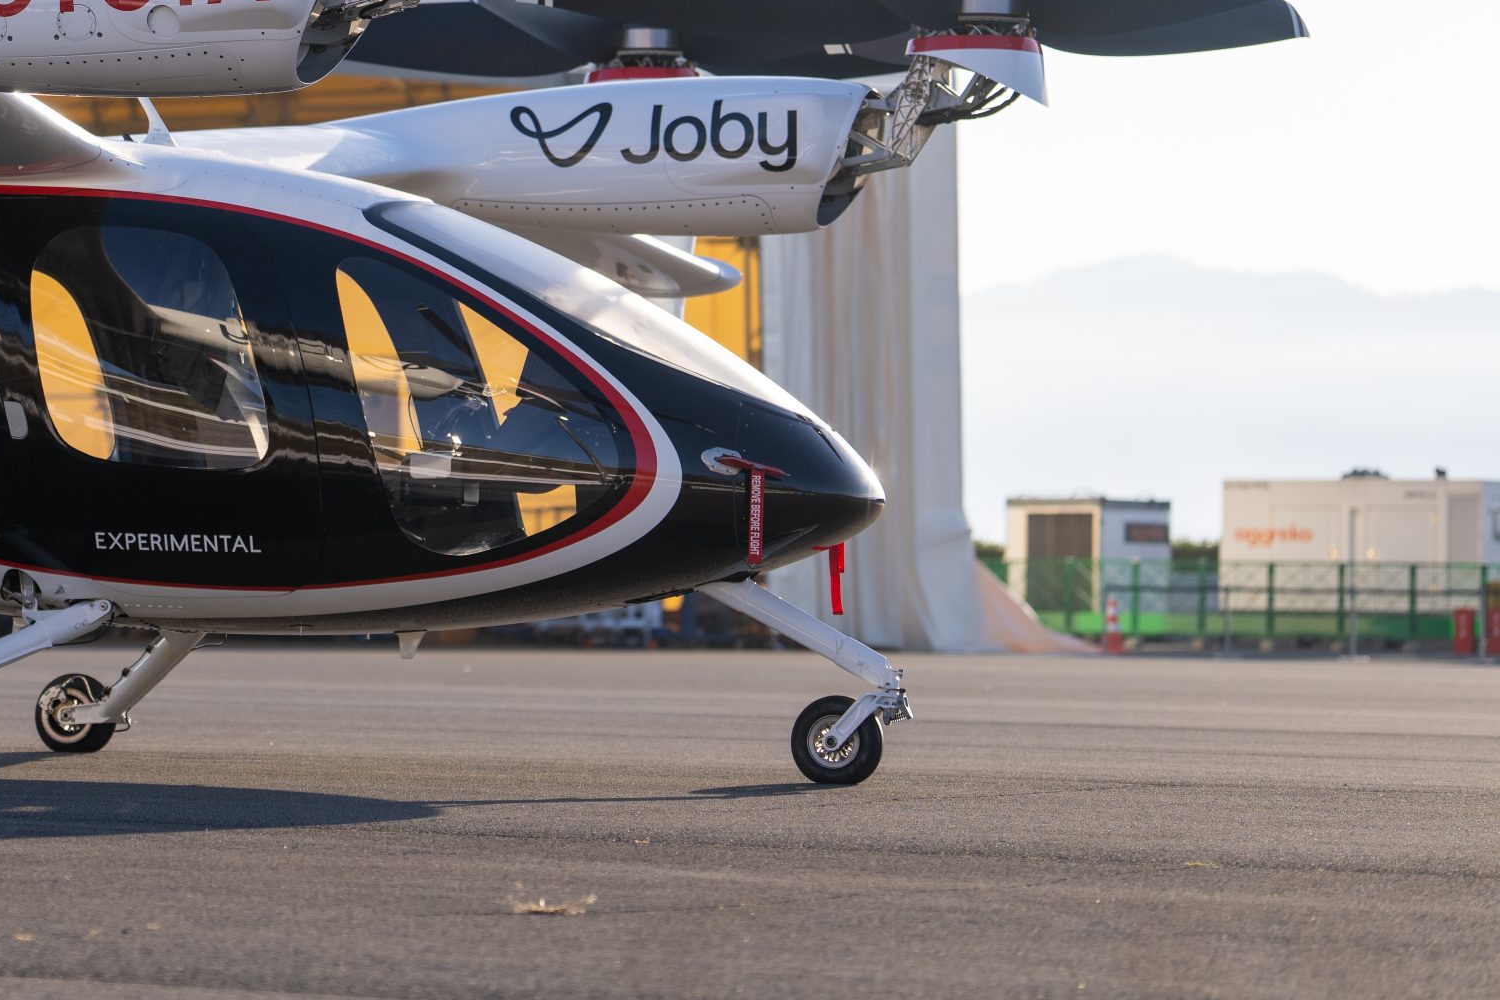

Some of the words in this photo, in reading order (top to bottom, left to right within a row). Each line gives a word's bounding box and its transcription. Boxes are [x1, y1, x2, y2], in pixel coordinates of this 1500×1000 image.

[620, 99, 798, 173] Joby
[751, 475, 762, 504] REMOVE
[750, 504, 761, 531] BEFORE
[94, 531, 262, 553] EXPERIMENTAL
[749, 532, 760, 556] FLIGHT
